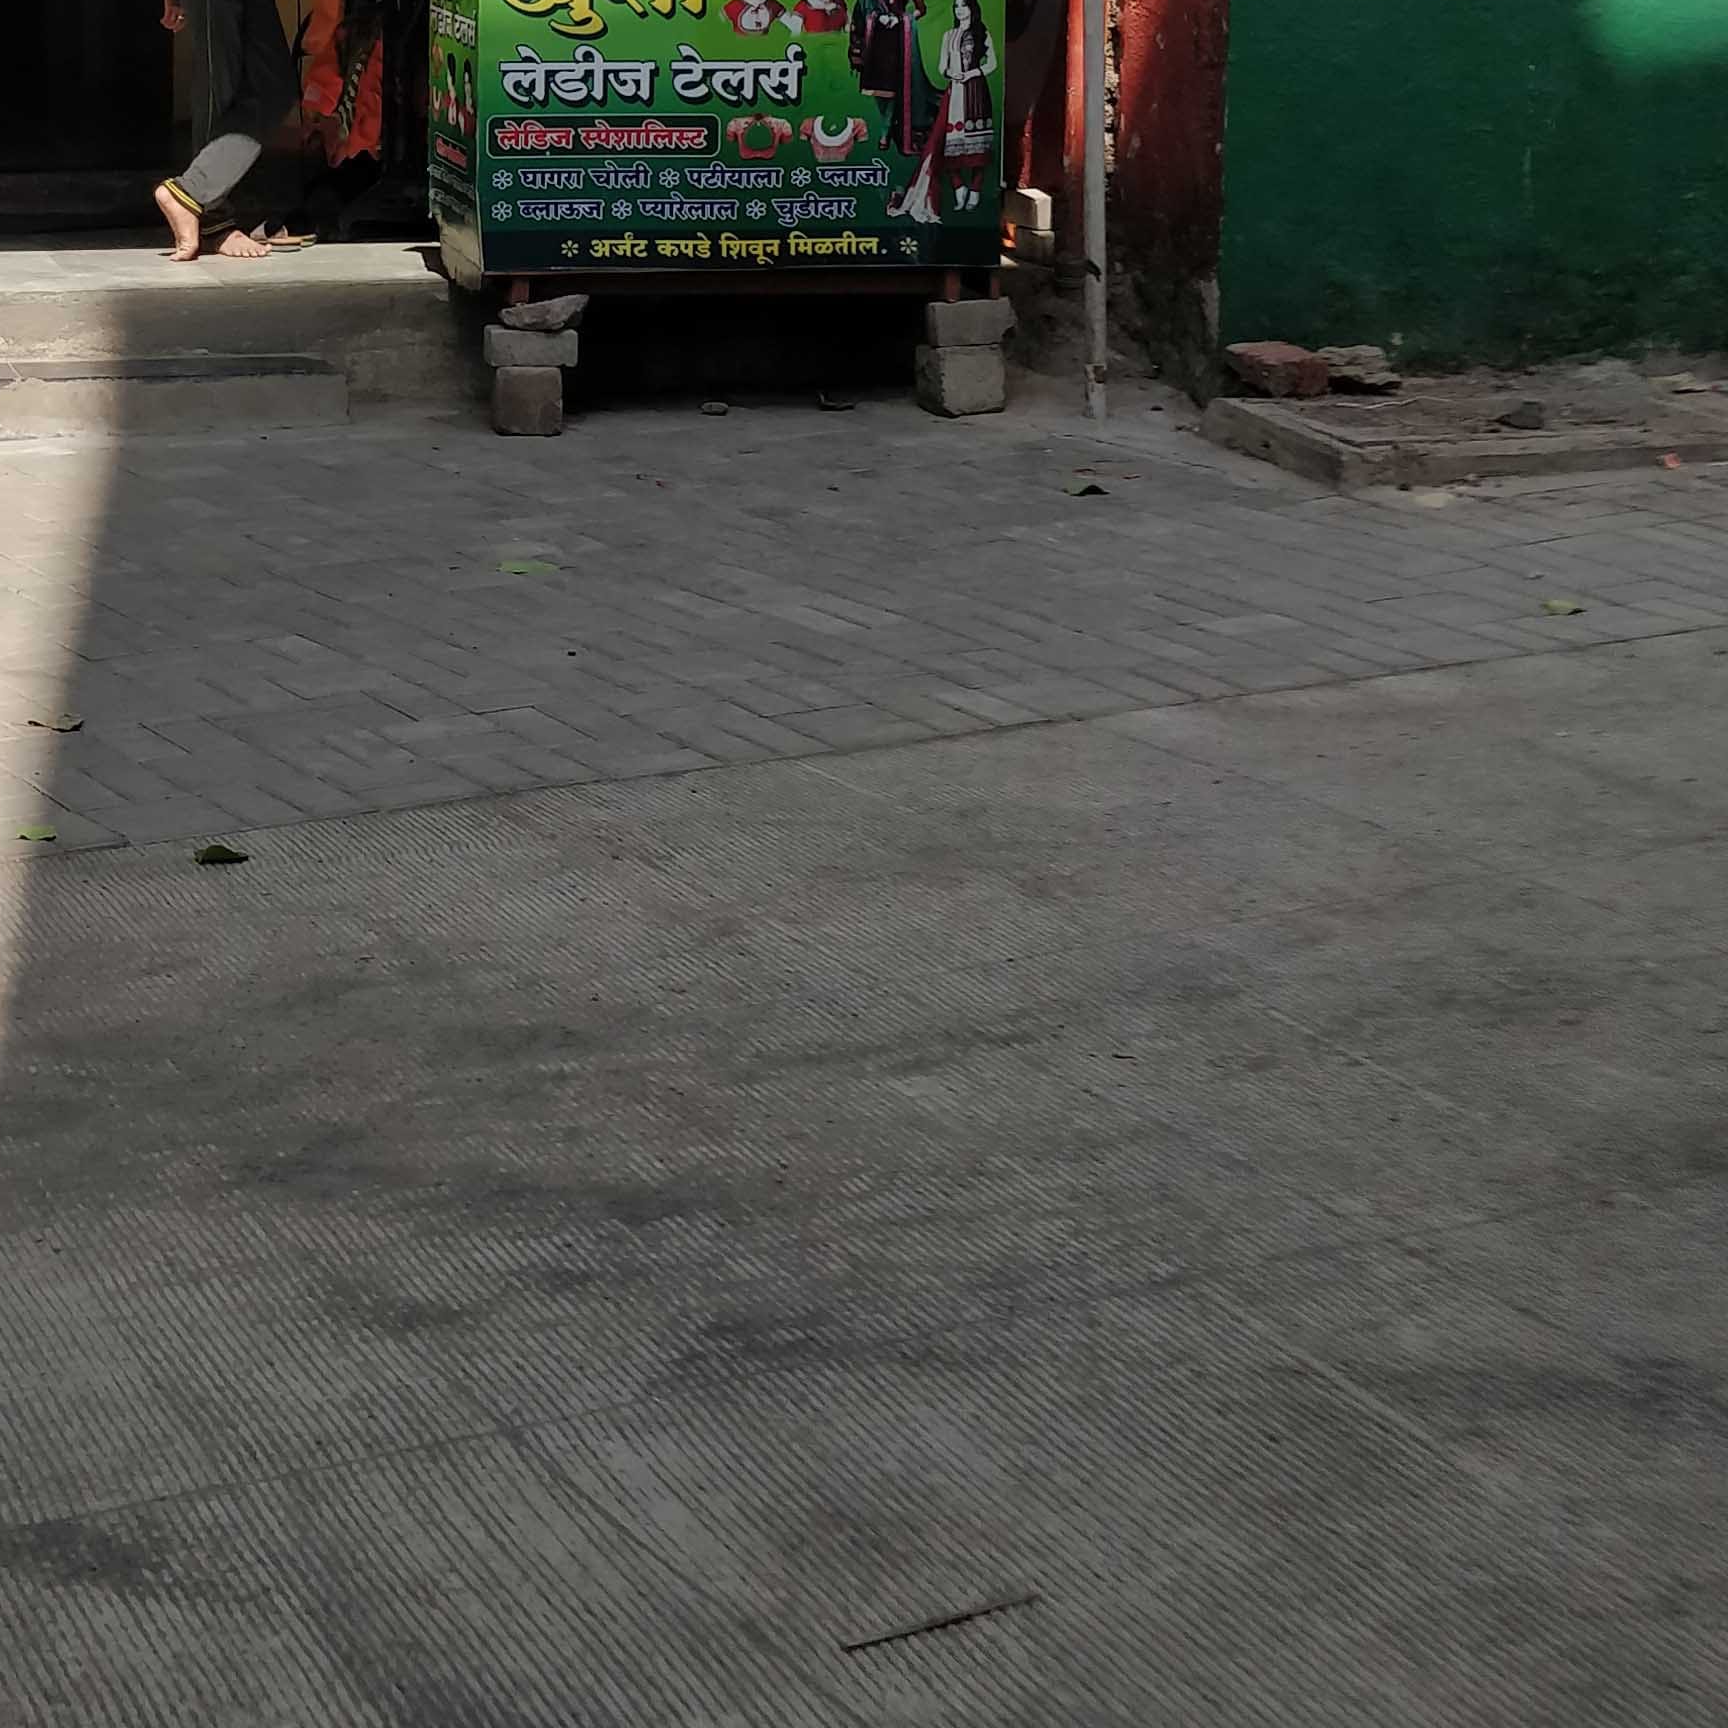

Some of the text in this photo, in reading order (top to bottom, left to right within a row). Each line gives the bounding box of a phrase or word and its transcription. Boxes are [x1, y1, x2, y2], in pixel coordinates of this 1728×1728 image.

[500, 43, 804, 102] लेडीज टेलर्स
[496, 120, 707, 150] लेडिज स्पेशालिस्ट
[588, 160, 652, 188] चोली
[684, 163, 784, 188] पटीयाला
[816, 158, 890, 187] प्लाजो
[517, 191, 857, 227] ब्लाऊज प्यारेलाल चुडीदार
[589, 233, 888, 264] अर्जंट कपडे शिवून मिळतील.
